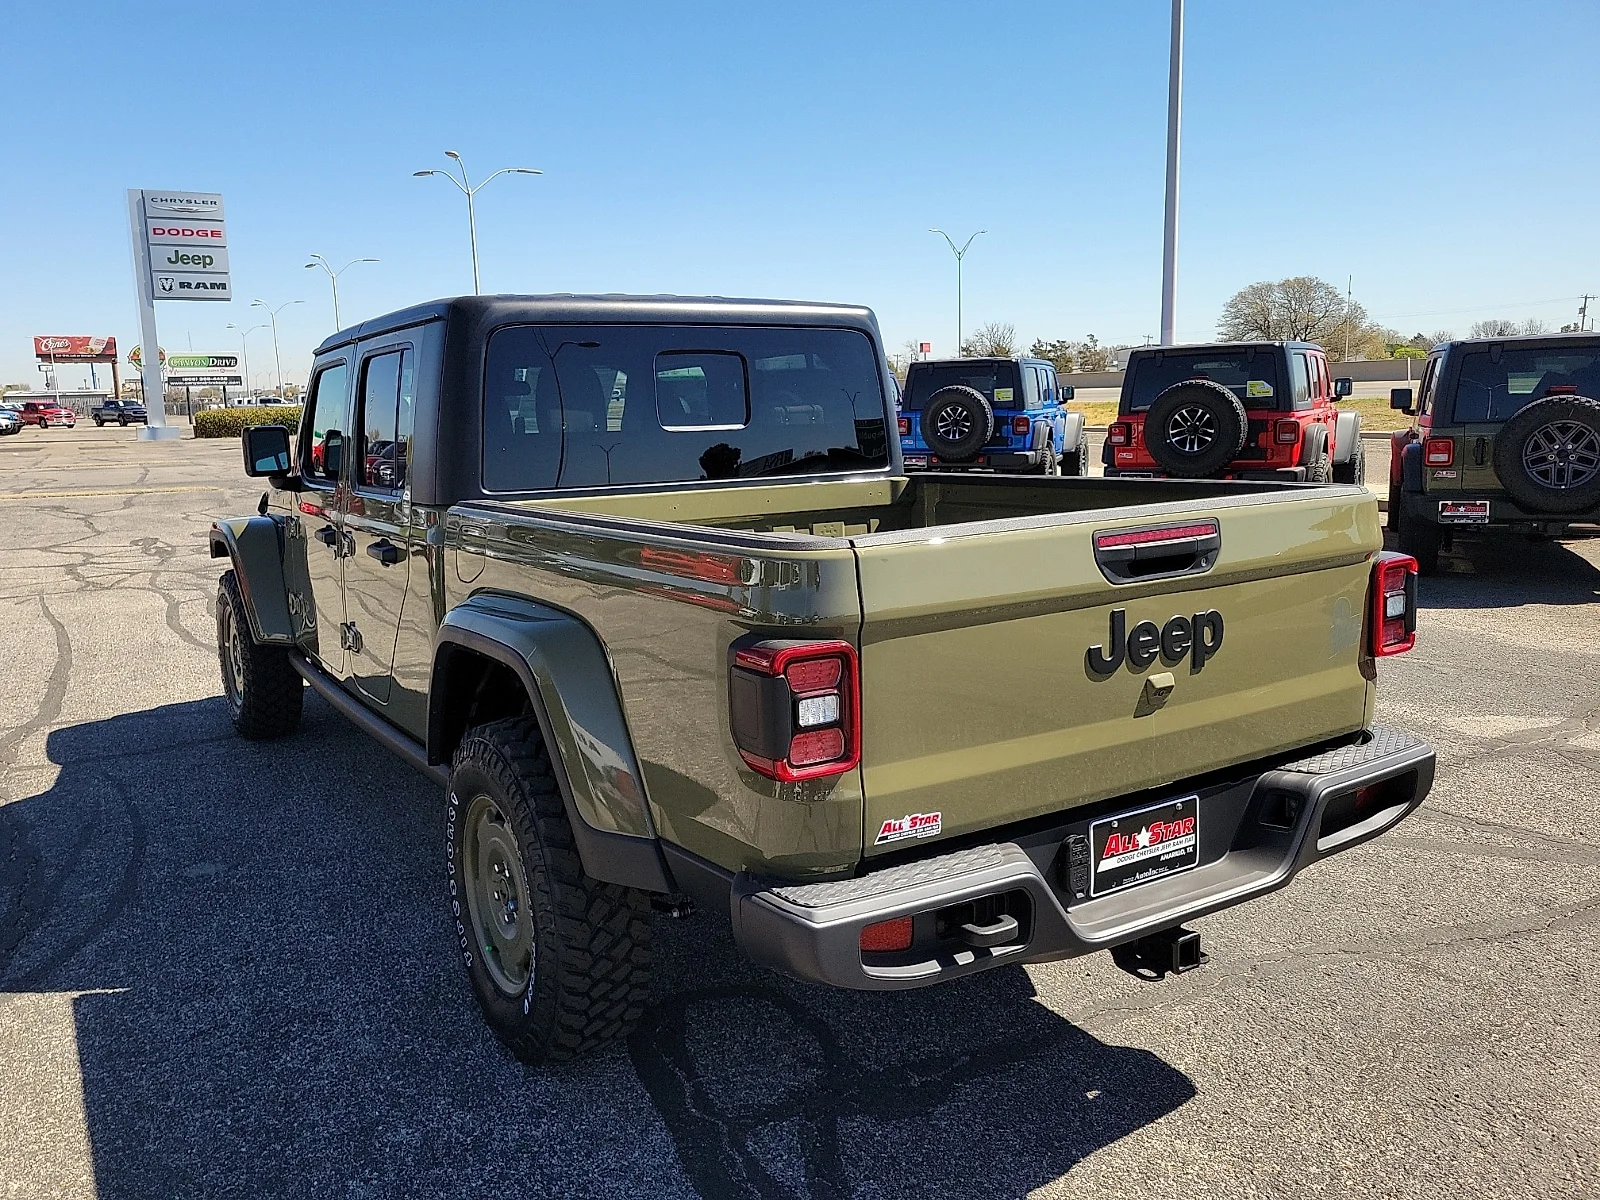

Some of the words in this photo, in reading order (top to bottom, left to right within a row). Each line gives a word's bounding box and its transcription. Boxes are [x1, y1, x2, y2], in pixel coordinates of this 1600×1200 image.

[150, 197, 218, 206] CHRYSLER
[152, 227, 223, 238] DODGE
[167, 249, 214, 269] Jeep
[178, 281, 227, 291] RAM
[209, 357, 237, 367] DRIVE
[1087, 608, 1224, 674] Jeep
[880, 821, 903, 835] ALL
[909, 814, 940, 829] STAR
[1102, 832, 1139, 859] ALL
[1147, 817, 1195, 846] STAR
